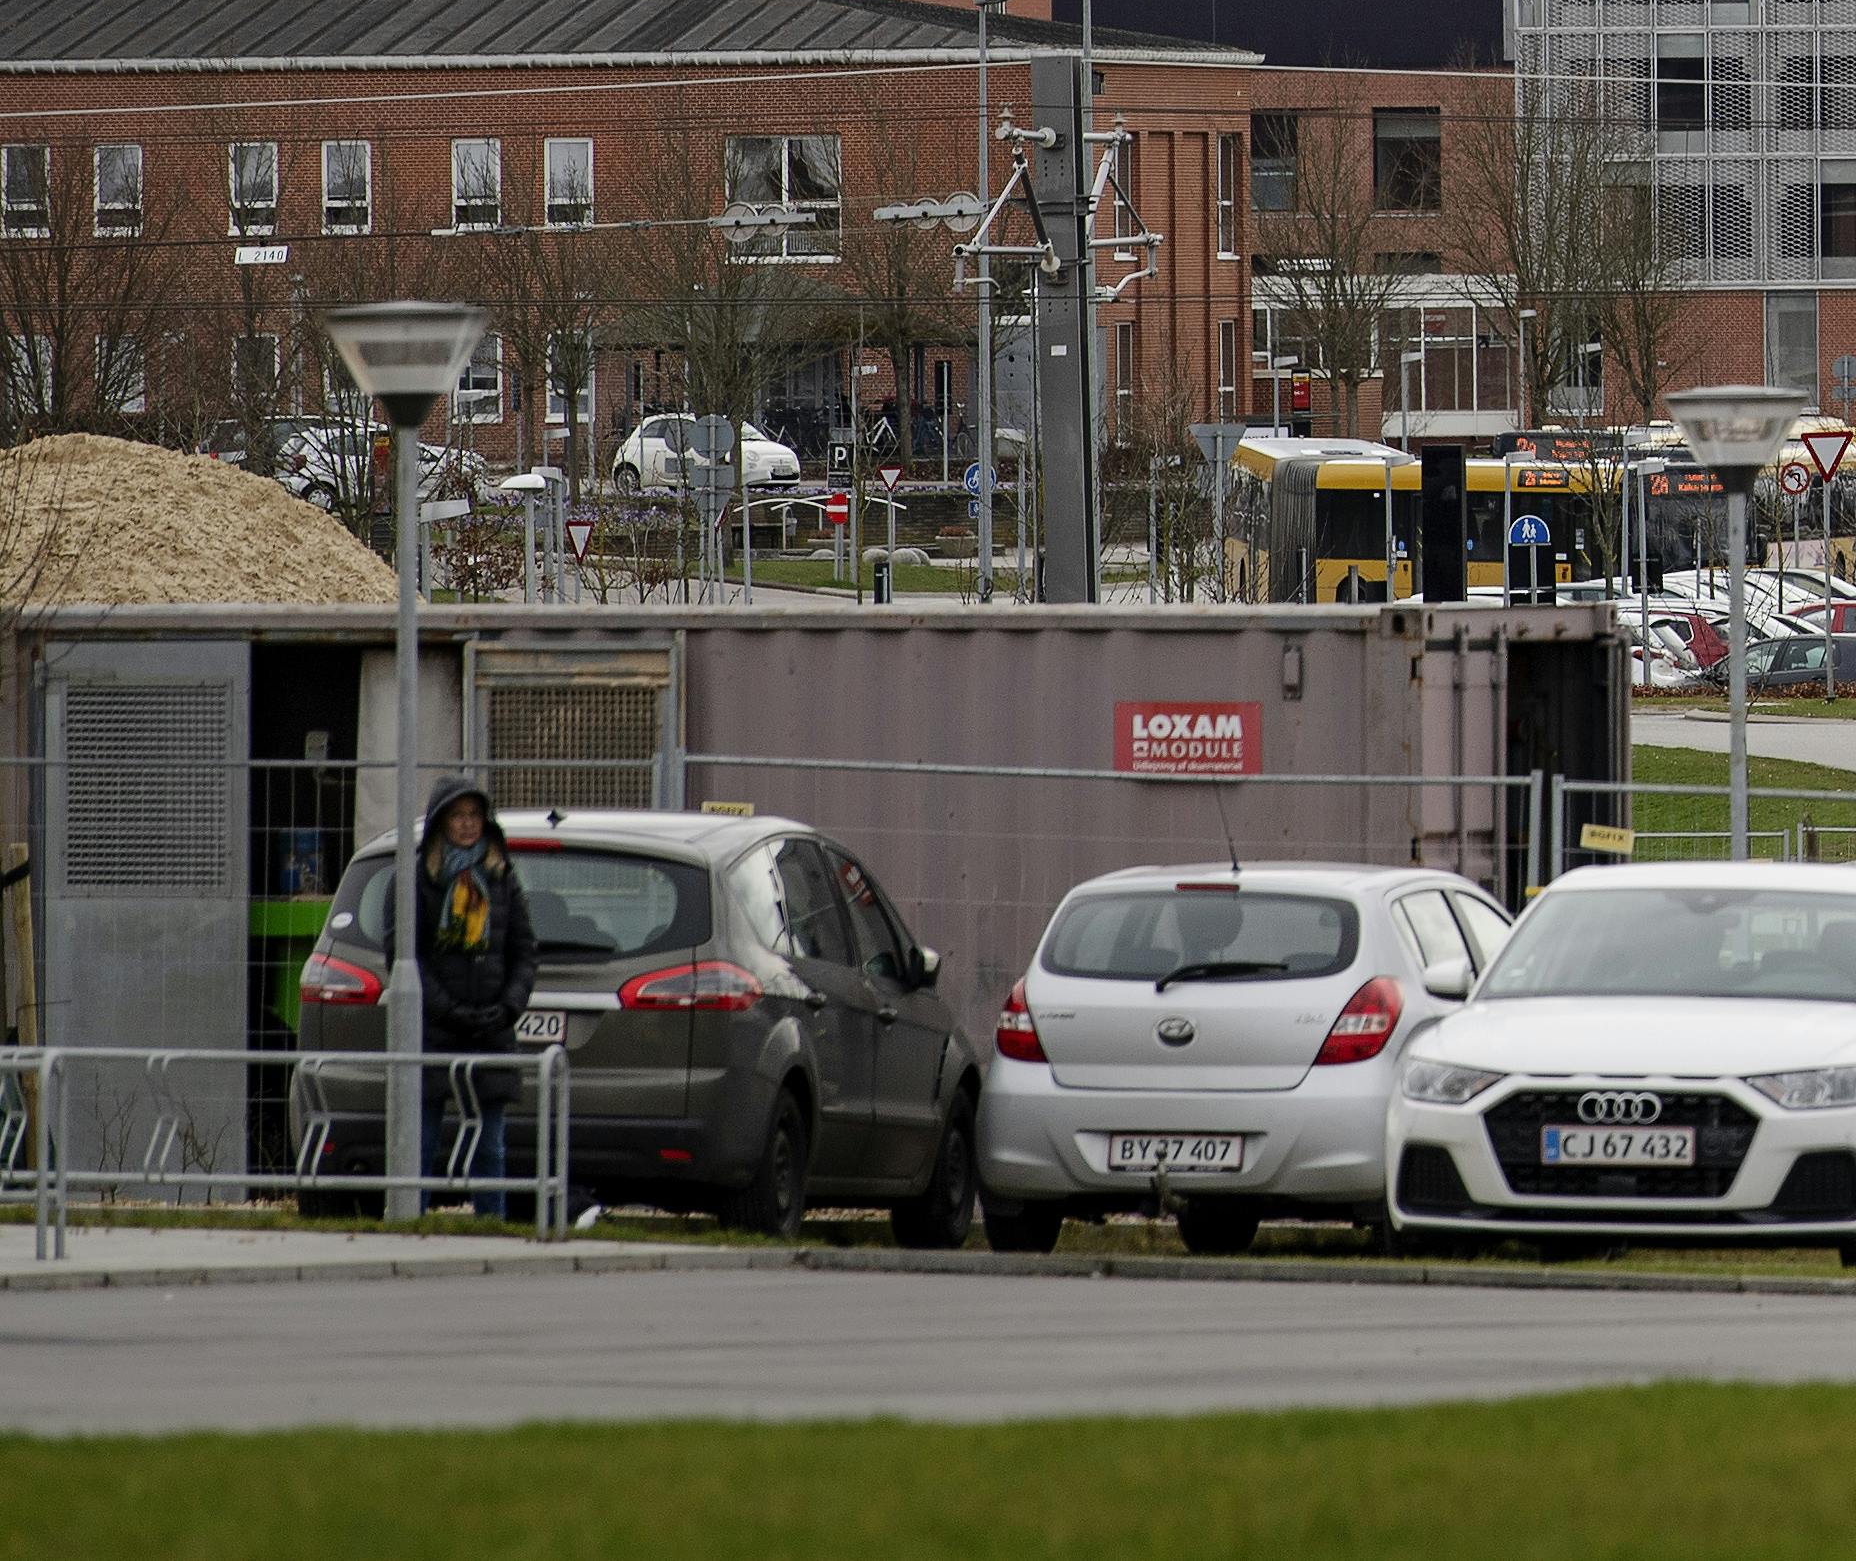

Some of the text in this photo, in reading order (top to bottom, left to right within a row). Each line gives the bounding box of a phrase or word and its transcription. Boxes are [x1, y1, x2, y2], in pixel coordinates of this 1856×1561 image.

[254, 250, 284, 262] 2140
[834, 446, 847, 469] P
[1132, 714, 1243, 739] LOXAM
[1150, 741, 1243, 759] MODULE
[517, 1014, 560, 1037] 420
[1121, 1139, 1152, 1160] BY
[1189, 1140, 1232, 1161] 407
[1562, 1133, 1688, 1159] CJ 67 432
